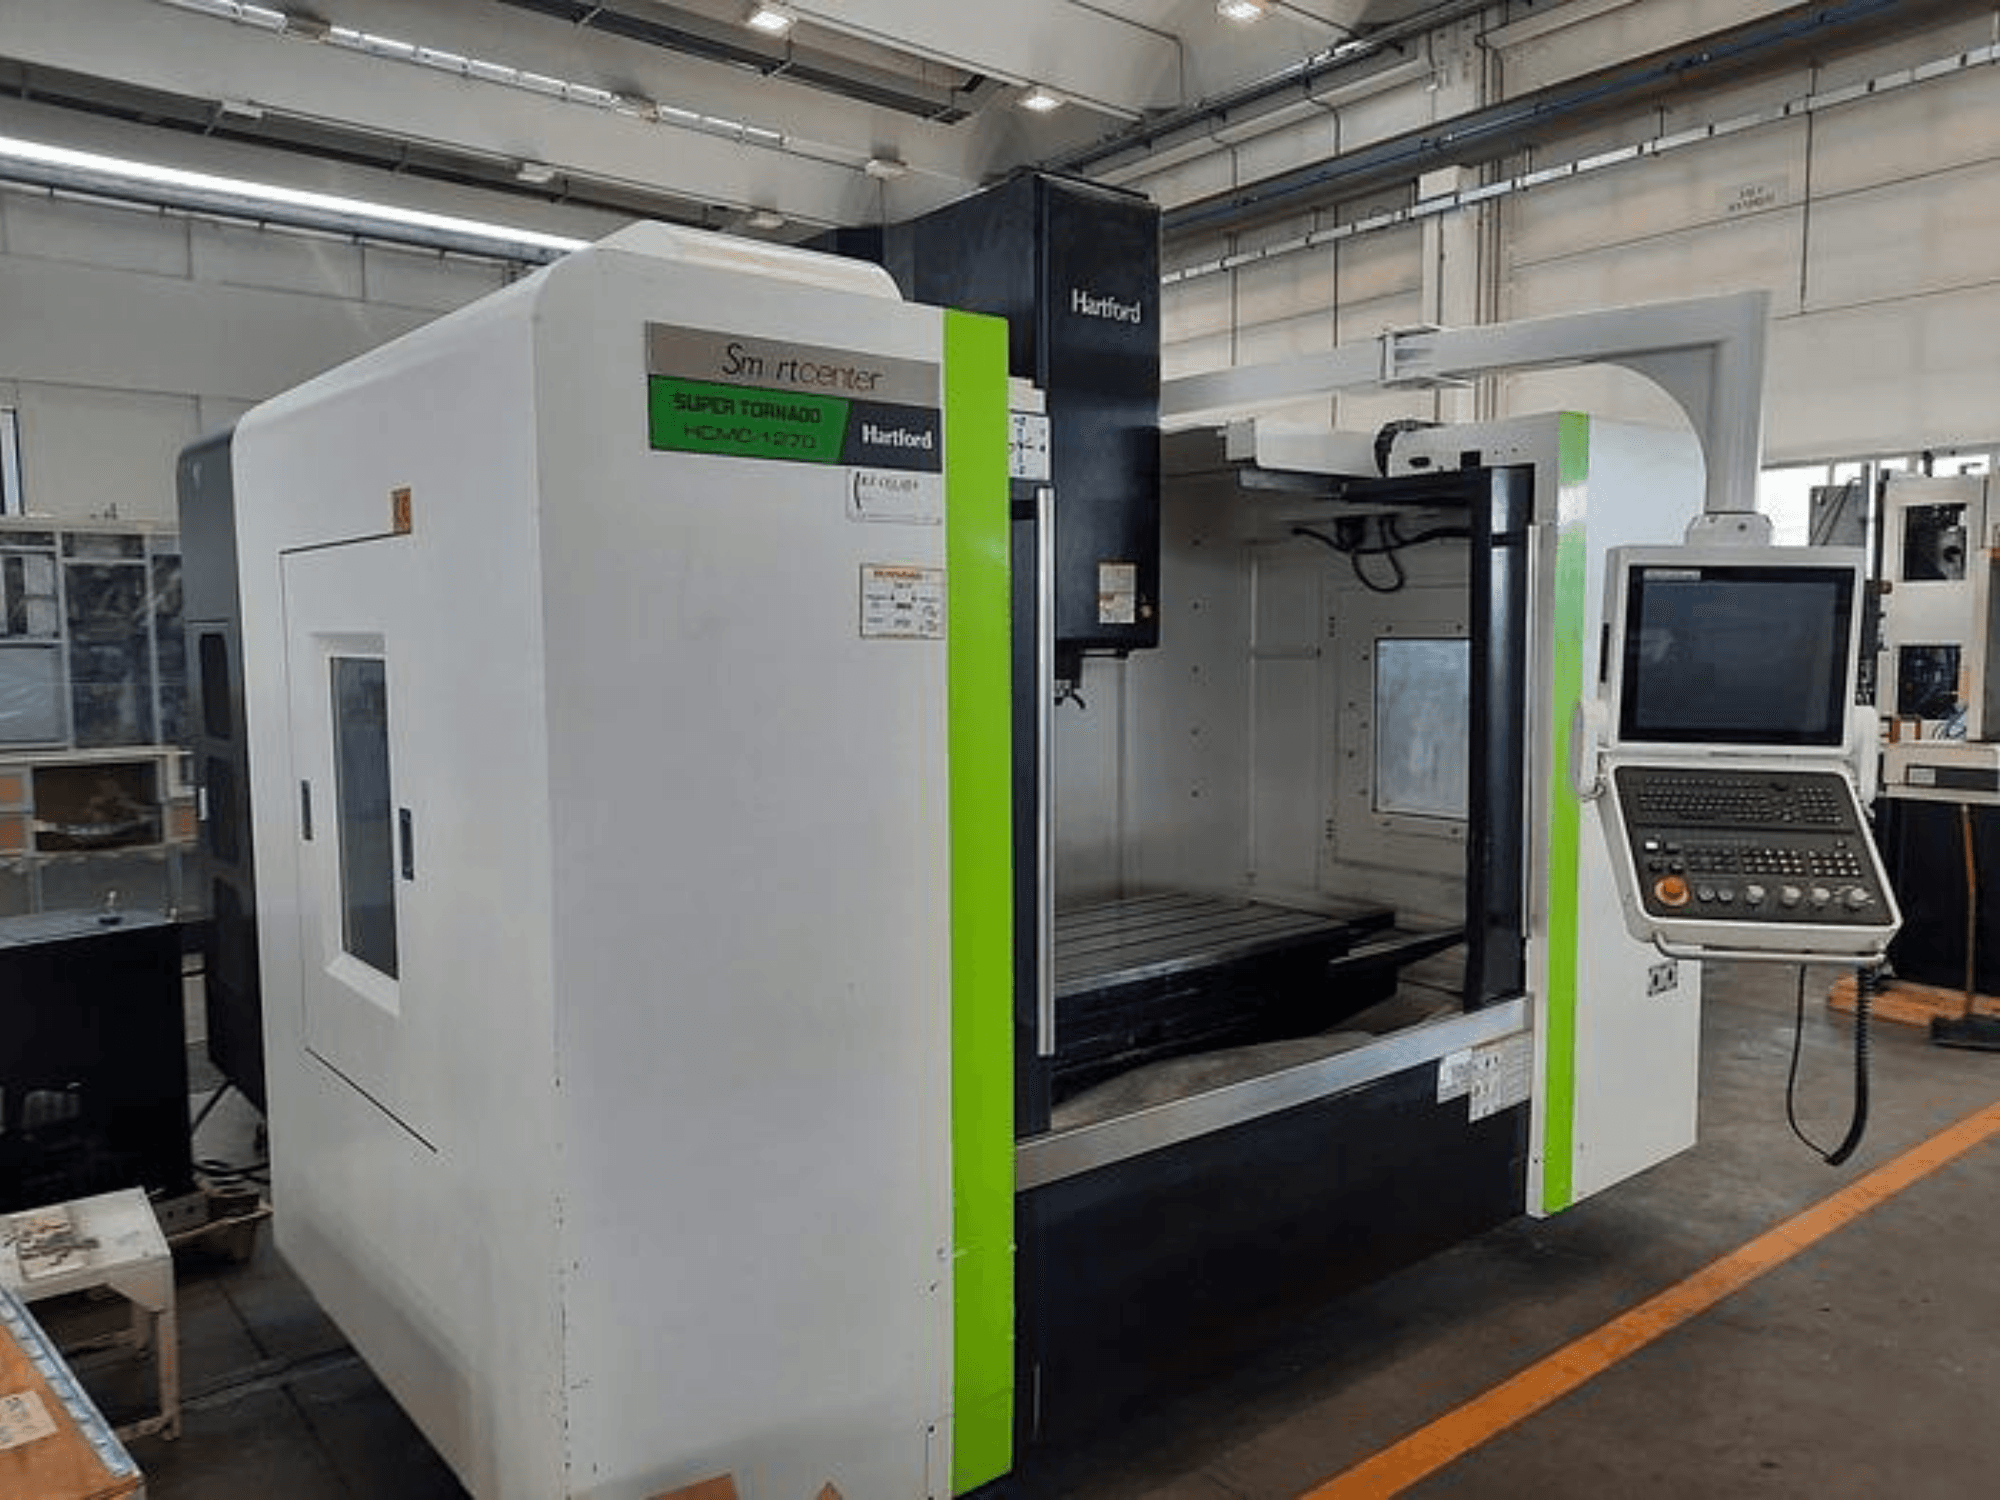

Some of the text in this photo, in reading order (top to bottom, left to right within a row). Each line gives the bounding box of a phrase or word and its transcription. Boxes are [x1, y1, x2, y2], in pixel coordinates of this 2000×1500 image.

[1072, 288, 1141, 324] Hartford
[722, 342, 883, 391] Smrtcenter
[673, 392, 820, 423] SUPER TORNADO
[861, 424, 932, 449] Hartford
